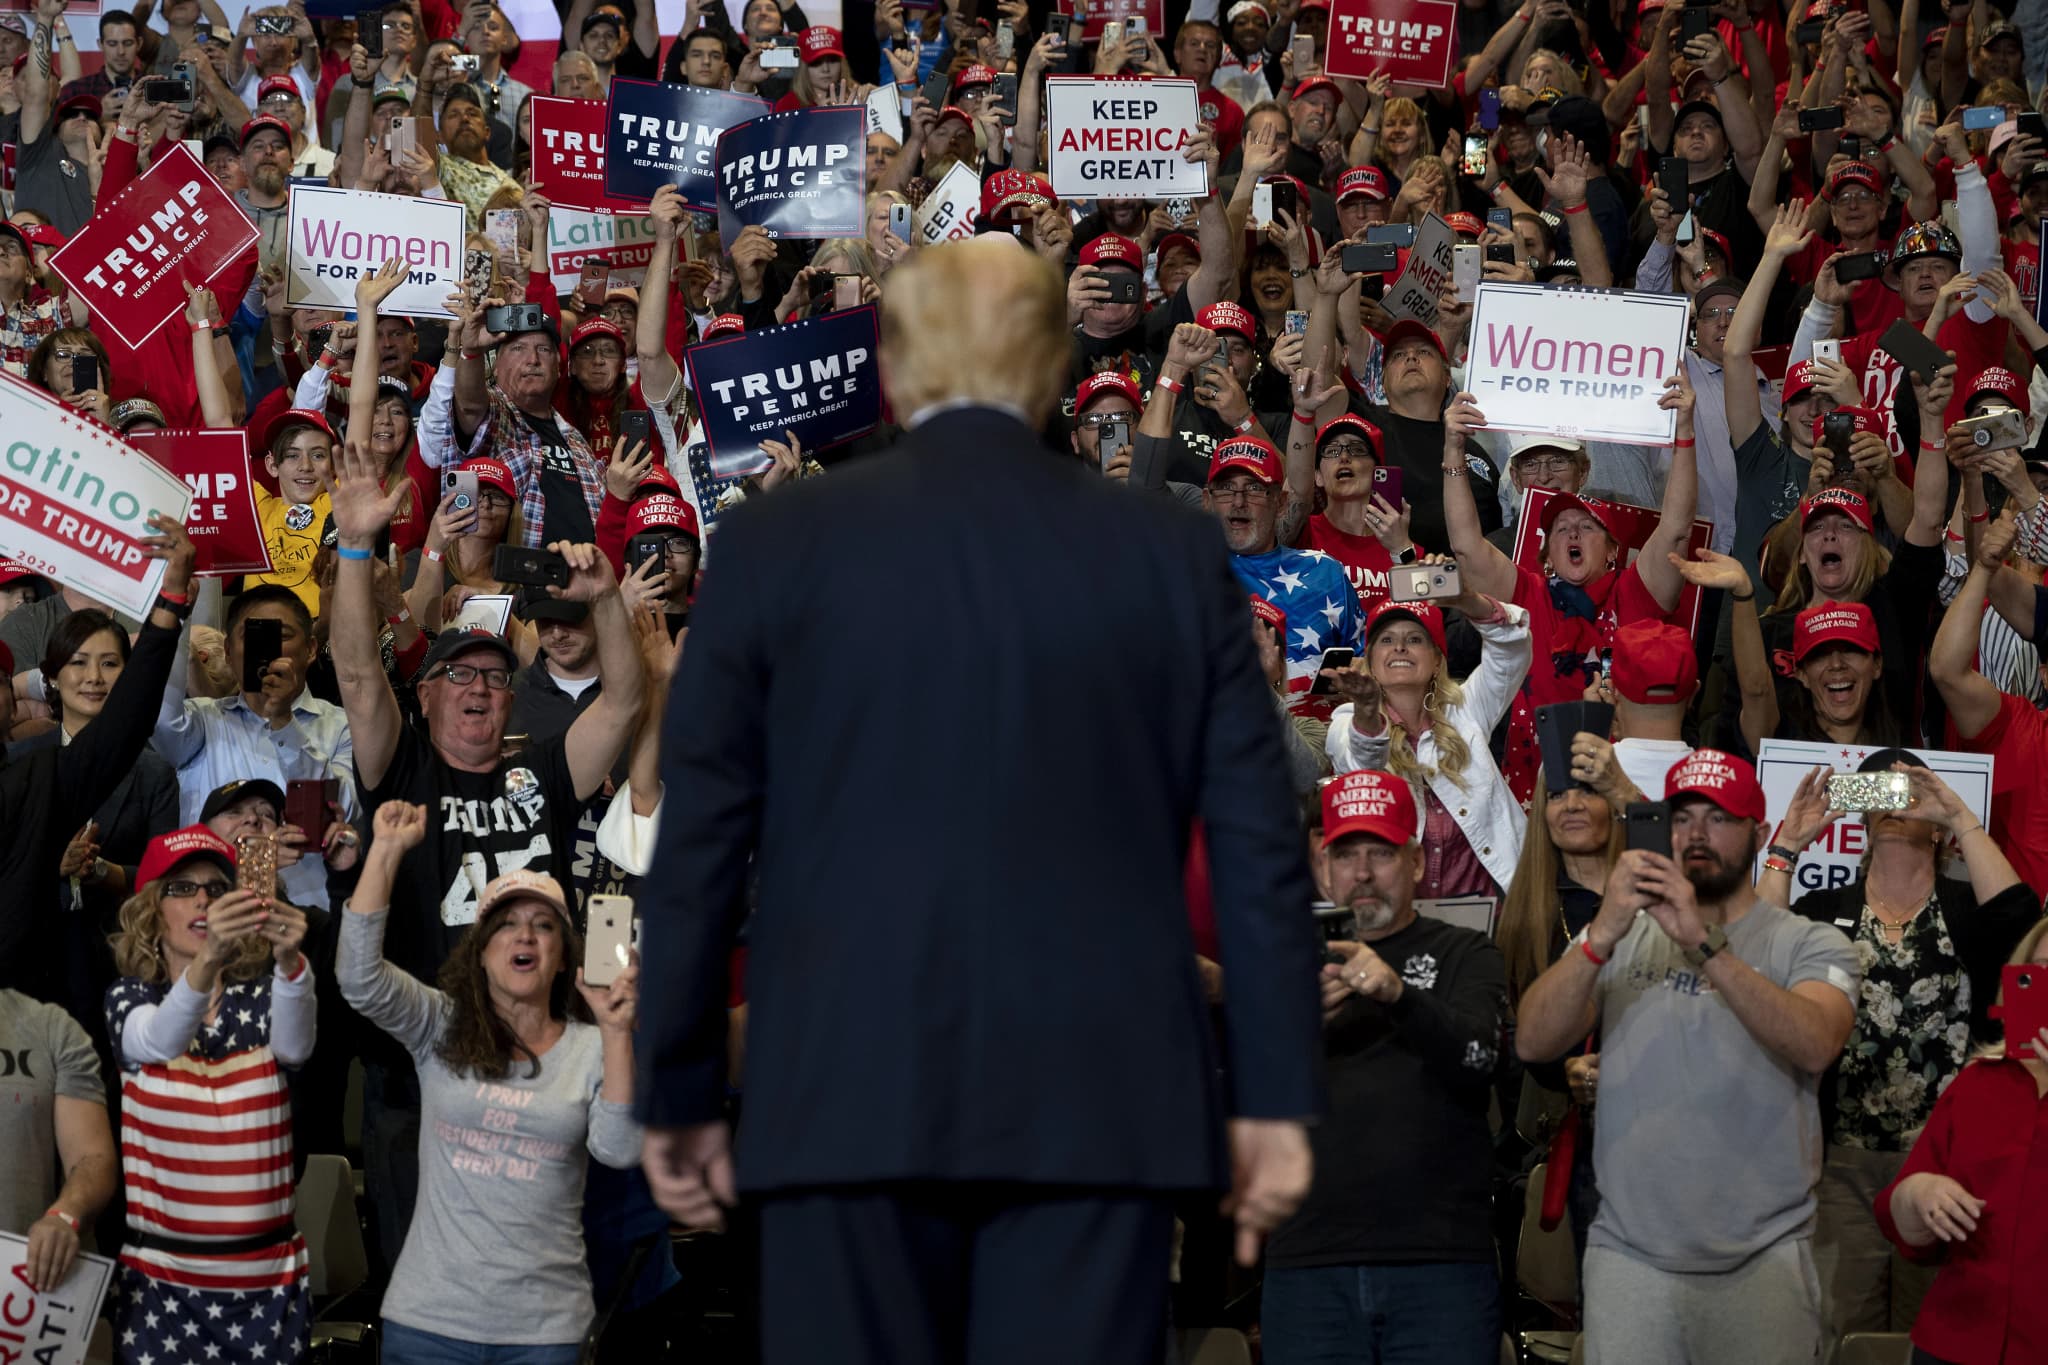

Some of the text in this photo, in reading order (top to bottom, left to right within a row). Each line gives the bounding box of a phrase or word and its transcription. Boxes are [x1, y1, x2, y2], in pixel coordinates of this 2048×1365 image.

[1089, 0, 1146, 12] ENCE
[811, 27, 828, 35] KEEP
[1338, 15, 1443, 40] TRUMP
[805, 32, 836, 44] AMERICA
[810, 40, 833, 50] GREAT
[1346, 34, 1431, 54] PENCE
[1368, 49, 1397, 58] AMERICA
[1398, 52, 1422, 61] GREAT!
[870, 108, 882, 132] UMP
[1093, 100, 1158, 120] KEEP
[542, 128, 604, 153] TRU
[618, 113, 724, 148] TRUM
[1058, 128, 1190, 152] AMERICA
[552, 153, 604, 170] PEN
[626, 140, 710, 164] PENC
[562, 170, 580, 178] KEEP
[634, 158, 716, 178] KEEP AMERICA GREA
[722, 144, 848, 185] TRUMP
[1080, 160, 1174, 180] GREAT!
[730, 171, 832, 200] PENCE
[991, 171, 1039, 197] USA
[1342, 172, 1378, 185] TRUMP
[735, 190, 821, 210] KEEP AMERICA GREAT!
[923, 201, 954, 240] EEP
[83, 180, 200, 288] TRUMP
[549, 216, 656, 247] Latino
[112, 208, 208, 298] PENCE
[302, 218, 450, 268] Women
[1094, 244, 1127, 253] AMERICA
[558, 247, 652, 270] FO TRU
[1432, 240, 1454, 267] KEE
[132, 229, 208, 299] KEEP AMERICA GREAT!
[316, 264, 436, 286] FOR TMP
[610, 280, 637, 288] 2020
[1408, 256, 1446, 298] AMER
[1216, 302, 1240, 310] KEEP
[1206, 309, 1248, 324] AMERICA
[1212, 318, 1243, 329] GREAT
[1488, 323, 1664, 379] Women
[711, 348, 868, 404] TRUMP
[1973, 374, 2016, 388] AMERICA
[1983, 366, 2008, 376] KEEP
[378, 376, 408, 392] UMP
[1090, 376, 1126, 388] AMERICA
[1500, 376, 1644, 400] FOR TRUMP
[1977, 381, 2010, 390] GREAT
[733, 378, 857, 422] PENCE
[750, 400, 848, 432] KEEP AMERICA GREAT!
[1556, 426, 1578, 434] 2020
[1219, 444, 1268, 460] TRUMP
[466, 464, 503, 475] Trump
[6, 441, 162, 534] atinos
[1809, 486, 1864, 506] TRUMP
[648, 494, 675, 504] KEEP
[1822, 496, 1848, 506] 2020
[636, 504, 686, 519] AMERICA
[643, 514, 680, 525] GREAT
[0, 484, 143, 567] OR TRUMP
[188, 526, 220, 535] GREAT!
[16, 550, 56, 574] 2020
[1358, 590, 1370, 598] 20
[1804, 610, 1860, 628] MAKE AMERICA
[1809, 620, 1858, 634] GREAT AGAIN
[1687, 750, 1726, 762] KEEP
[1344, 774, 1382, 789] KEEP
[1672, 762, 1736, 782] AMERICA
[1677, 774, 1726, 789] GREAT
[1332, 788, 1396, 807] AMERICA
[1338, 802, 1387, 818] GREAT
[440, 833, 552, 926] 45
[476, 1083, 534, 1108] I PRAY
[482, 1108, 518, 1130] FOR
[452, 1150, 540, 1180] EVERY DAY
